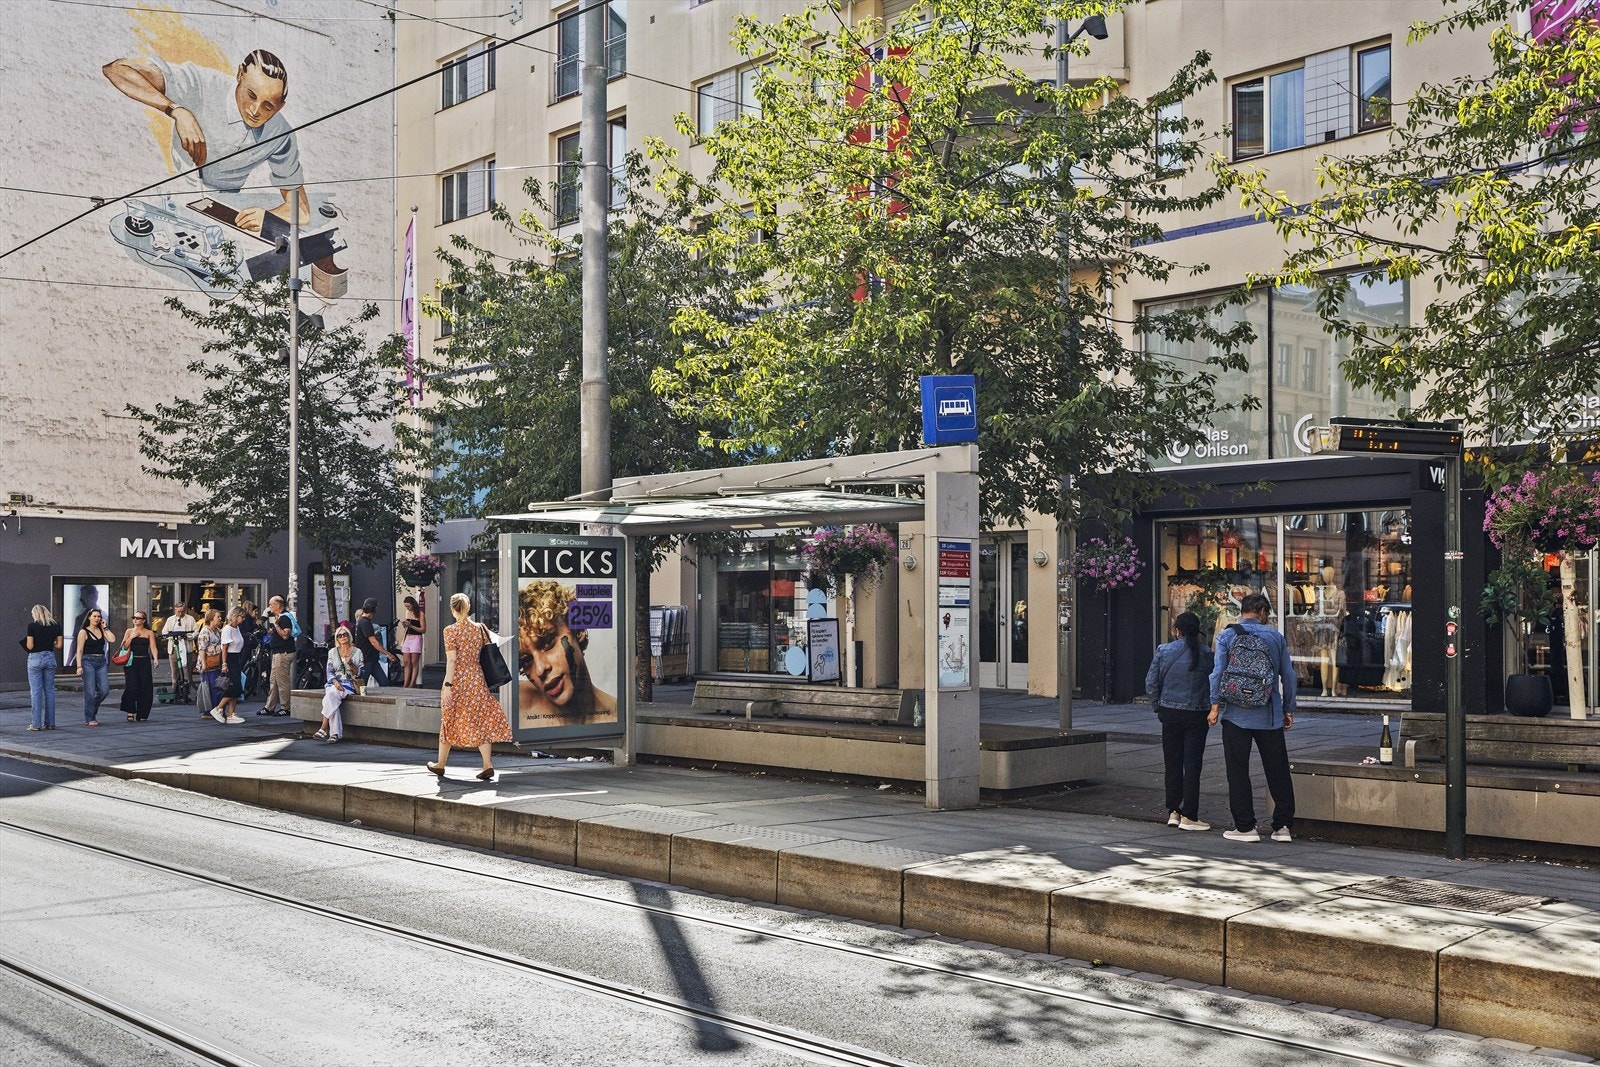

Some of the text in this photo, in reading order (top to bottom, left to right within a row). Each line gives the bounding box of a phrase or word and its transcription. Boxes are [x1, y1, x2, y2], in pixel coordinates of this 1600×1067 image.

[1194, 443, 1248, 458] Ohlson
[120, 537, 215, 559] MATCH
[521, 549, 613, 575] KICKS
[577, 586, 611, 598] Hudpleie
[1226, 585, 1341, 618] SALE
[570, 603, 611, 626] 25%
